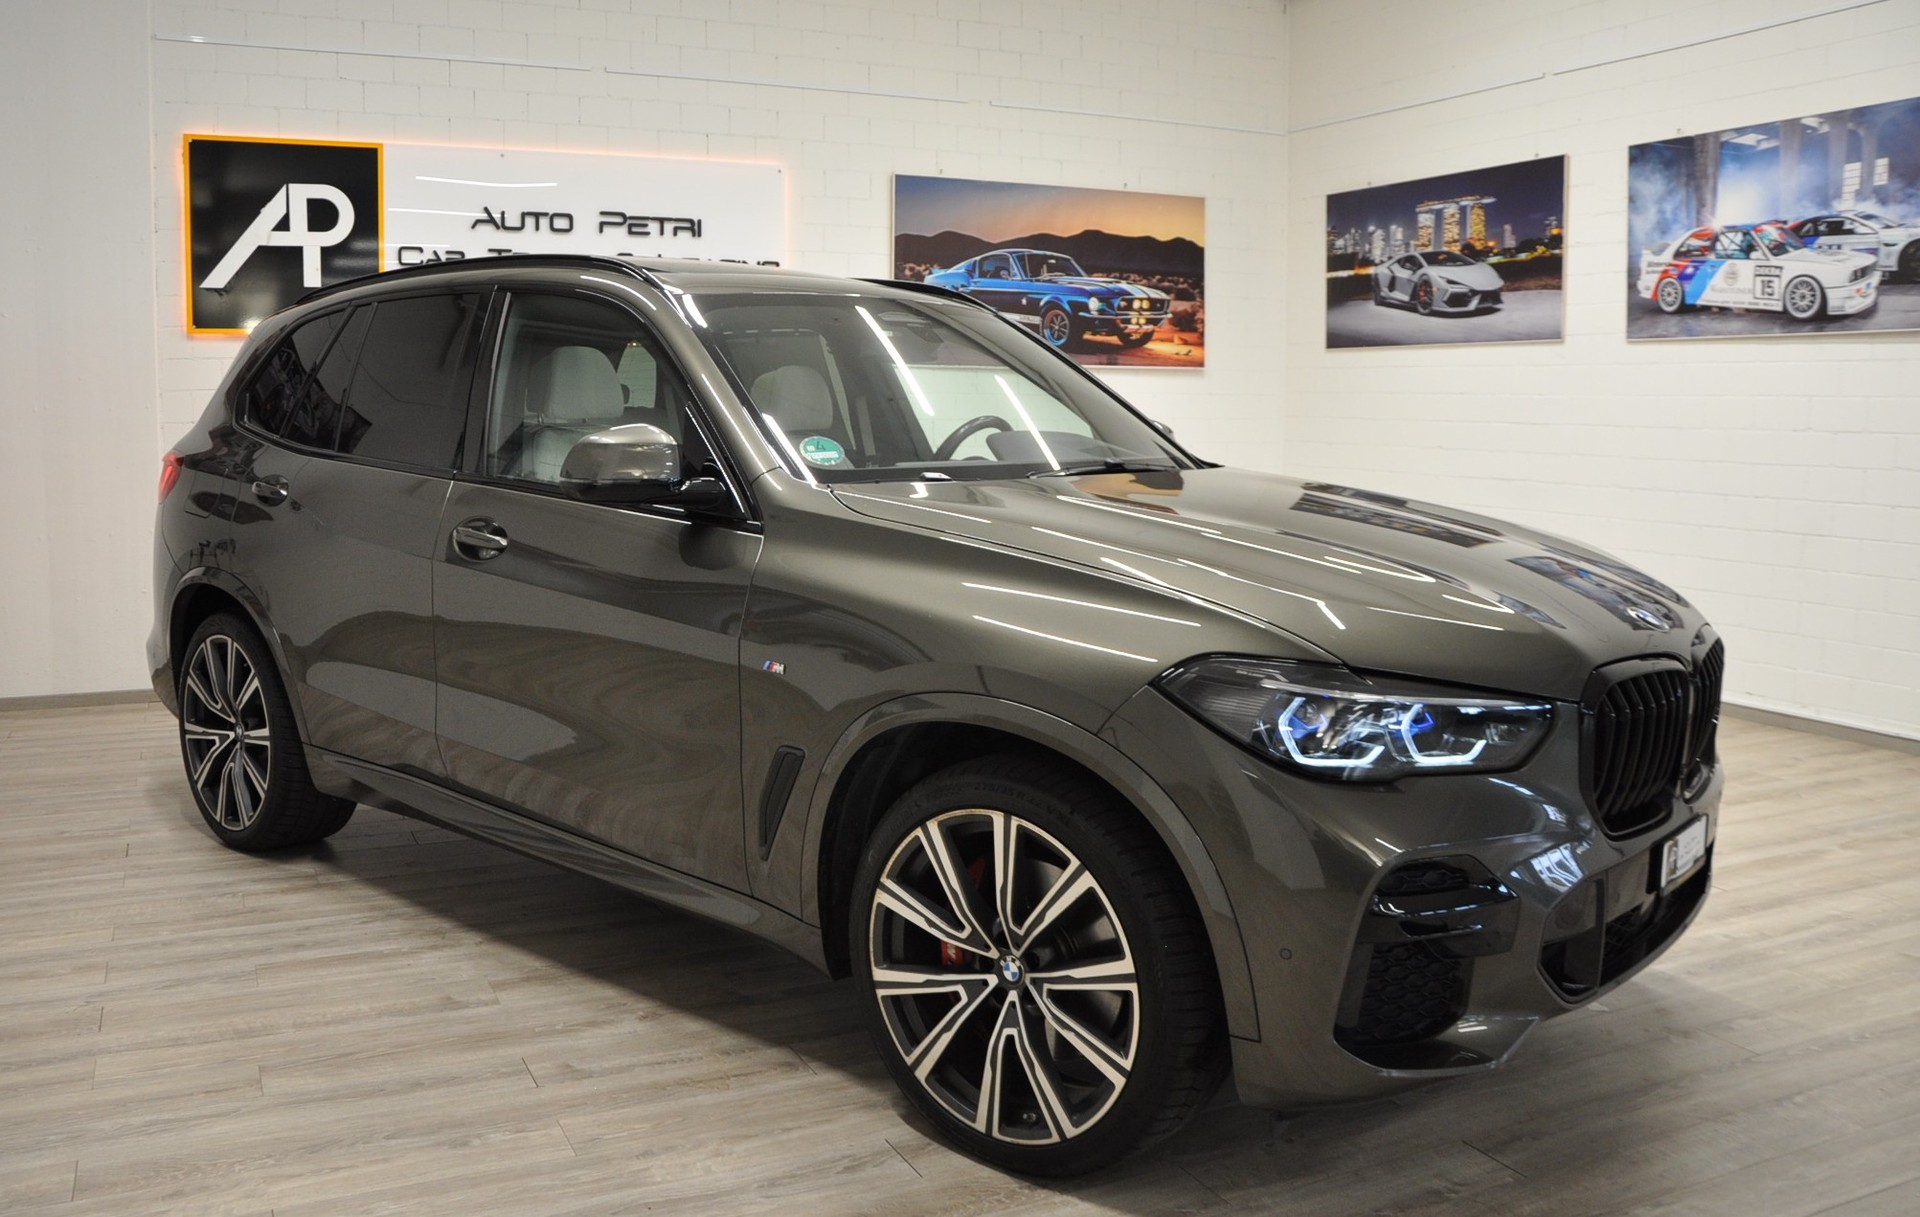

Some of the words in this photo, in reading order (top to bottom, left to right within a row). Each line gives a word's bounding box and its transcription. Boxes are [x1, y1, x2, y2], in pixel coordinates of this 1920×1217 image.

[199, 183, 355, 289] AP
[471, 206, 574, 233] AUTO
[598, 211, 702, 238] PETRI
[1760, 279, 1775, 297] 15
